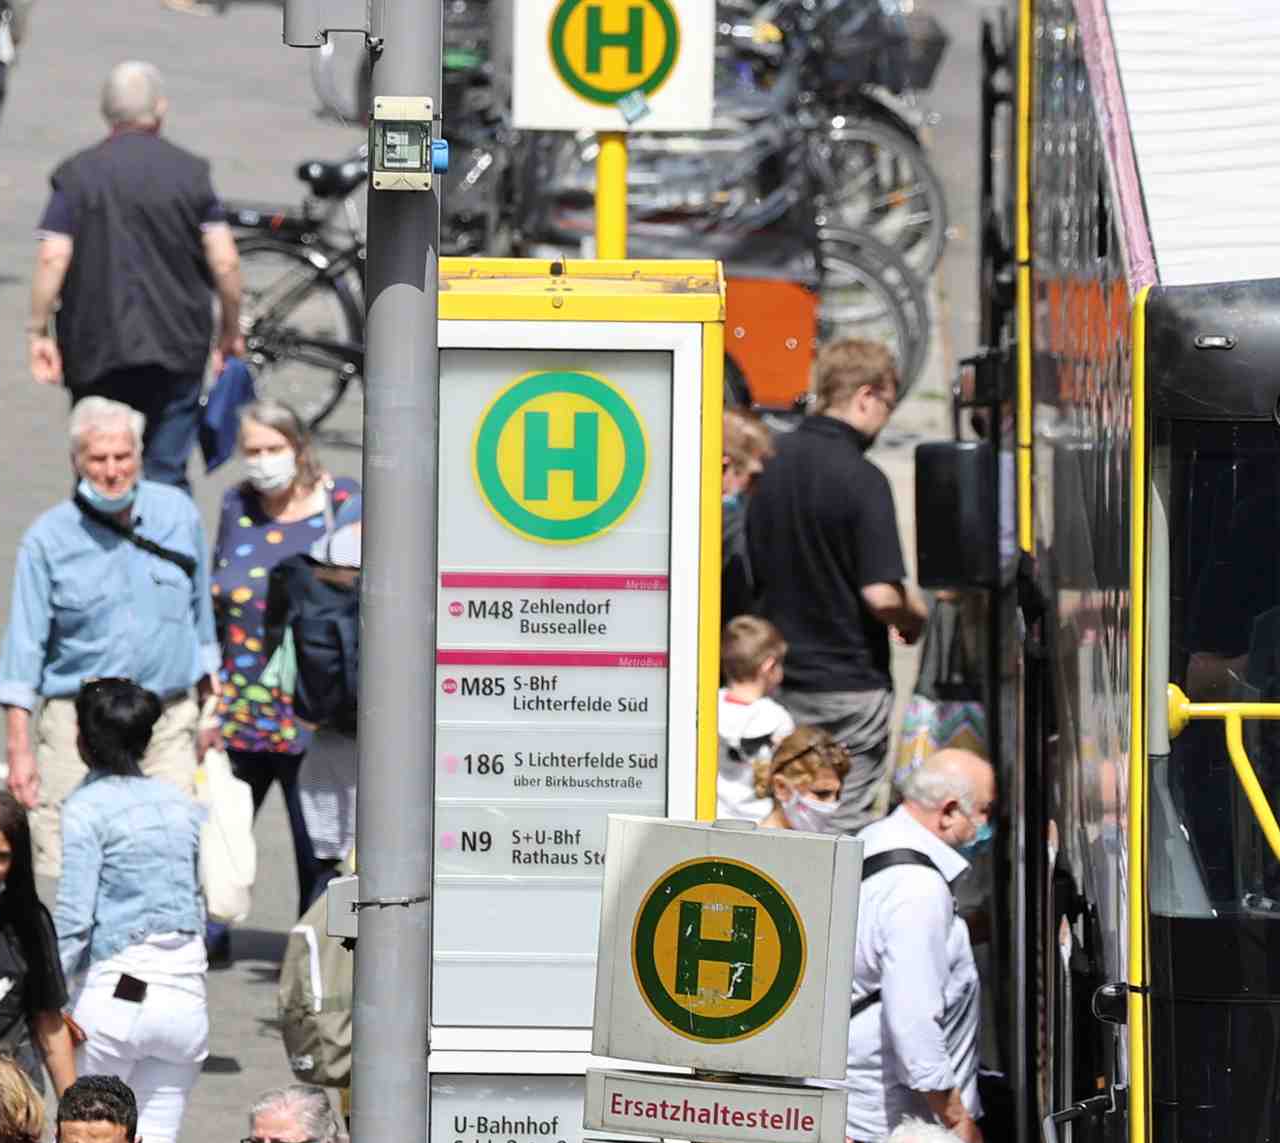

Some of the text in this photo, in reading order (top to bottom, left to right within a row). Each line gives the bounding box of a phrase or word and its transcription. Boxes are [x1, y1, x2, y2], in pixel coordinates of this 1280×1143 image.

[586, 6, 644, 73] H
[524, 412, 598, 501] H
[468, 600, 513, 619] M48
[520, 598, 611, 615] Zehlendorf
[520, 619, 607, 635] Busseallee
[461, 677, 505, 696] M85
[513, 676, 558, 691] S-Bhf
[513, 696, 648, 712] Lichterfelde Süd
[463, 752, 658, 775] 186 S Lichterfelde Süd
[513, 775, 642, 788] über Birkbuschstraße
[461, 830, 581, 852] N9 S+U-Bhf
[512, 849, 578, 865] Rathaus
[675, 900, 757, 1000] H
[611, 1093, 814, 1131] Ersatzhaltestelle
[454, 1115, 559, 1135] U-Bahnhof
